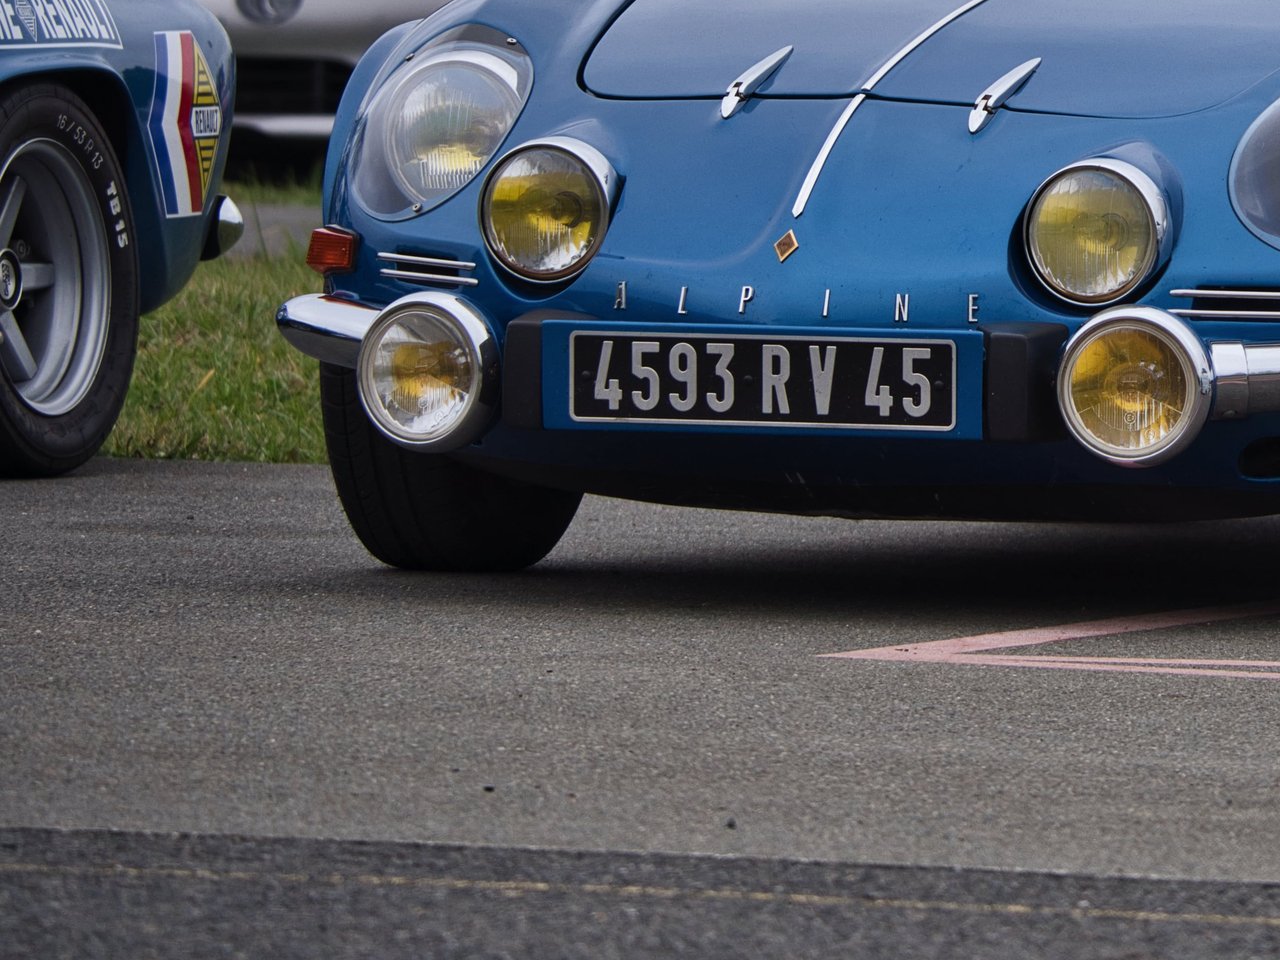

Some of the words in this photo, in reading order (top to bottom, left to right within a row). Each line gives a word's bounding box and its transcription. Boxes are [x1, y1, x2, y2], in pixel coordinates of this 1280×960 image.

[195, 109, 218, 134] RENAULT
[613, 280, 979, 323] ALPINE
[593, 340, 736, 413] 4593
[864, 346, 932, 418] 45
